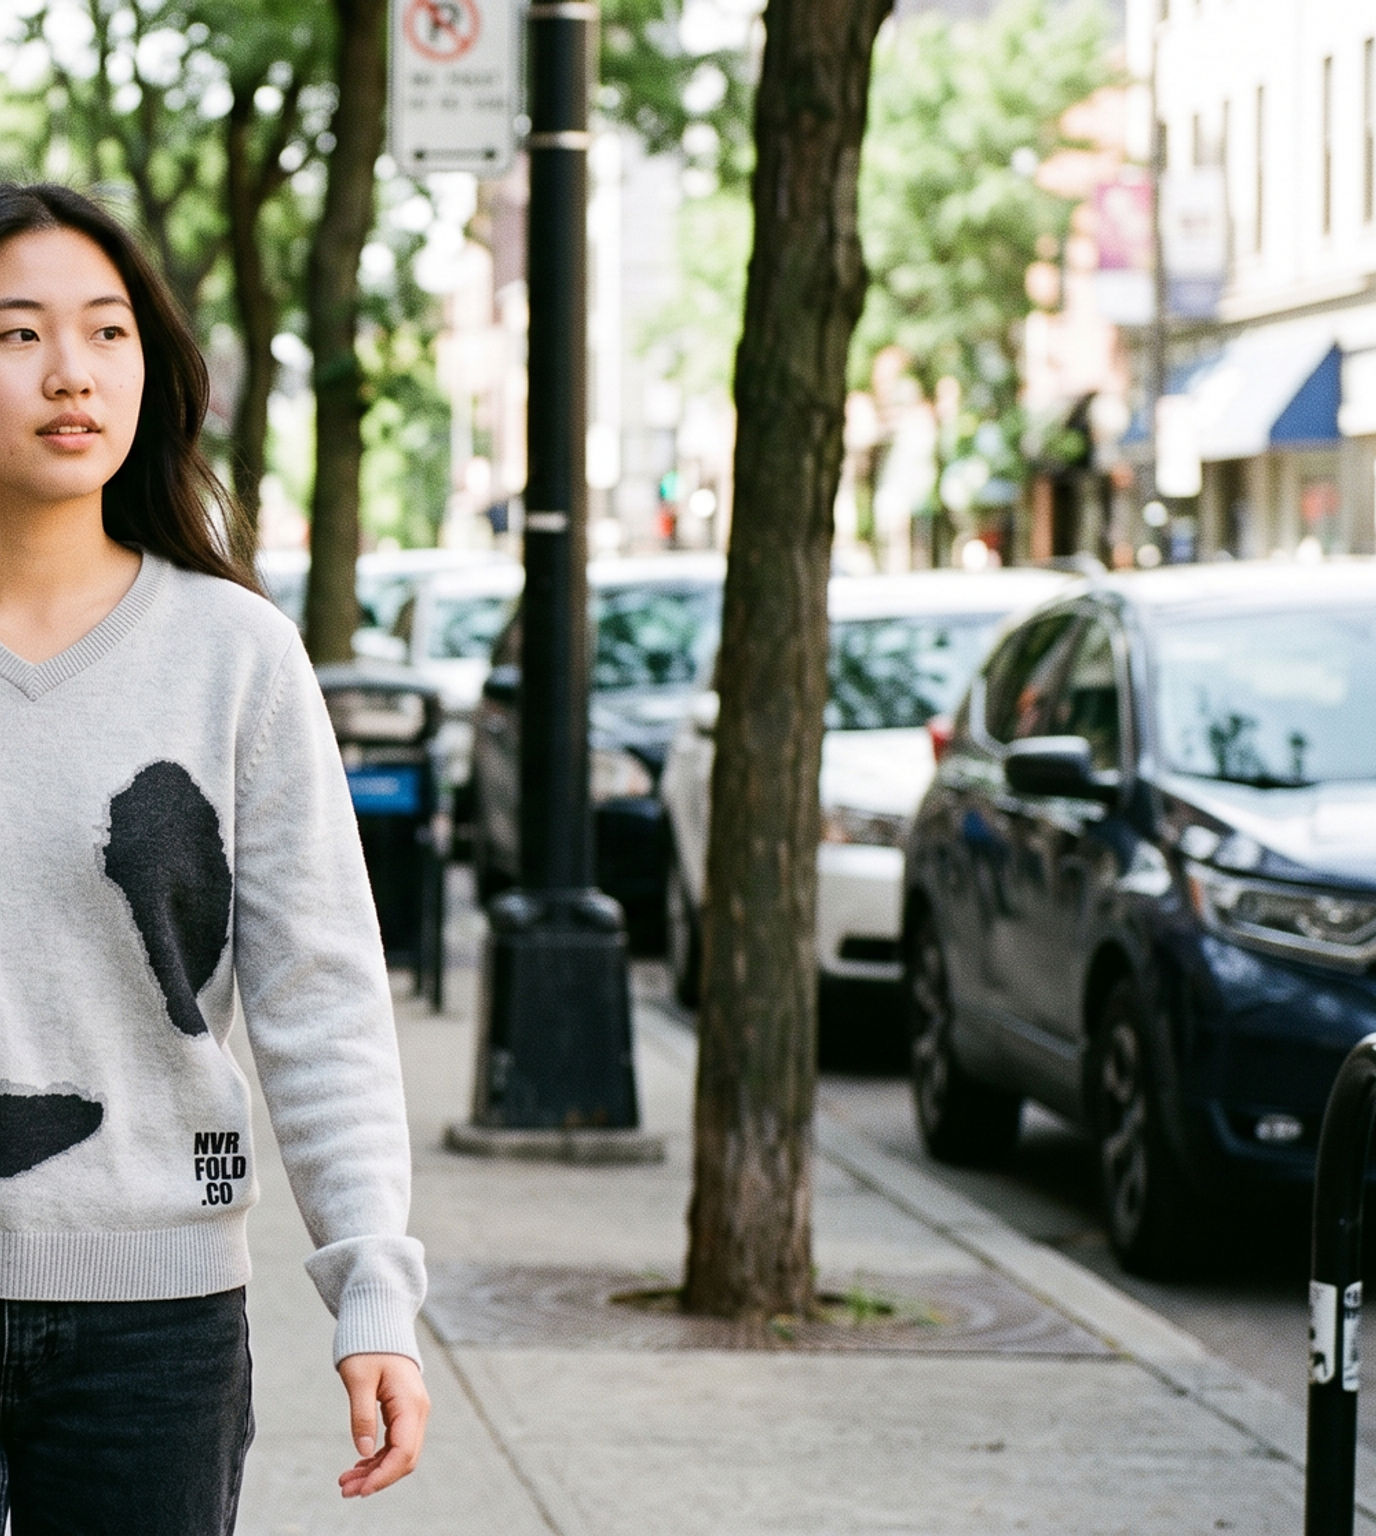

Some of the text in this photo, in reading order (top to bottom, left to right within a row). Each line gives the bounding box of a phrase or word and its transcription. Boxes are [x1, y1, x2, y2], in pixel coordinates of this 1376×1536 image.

[194, 1132, 240, 1155] NVR
[194, 1156, 247, 1181] FOLD
[201, 1181, 233, 1206] .CO
